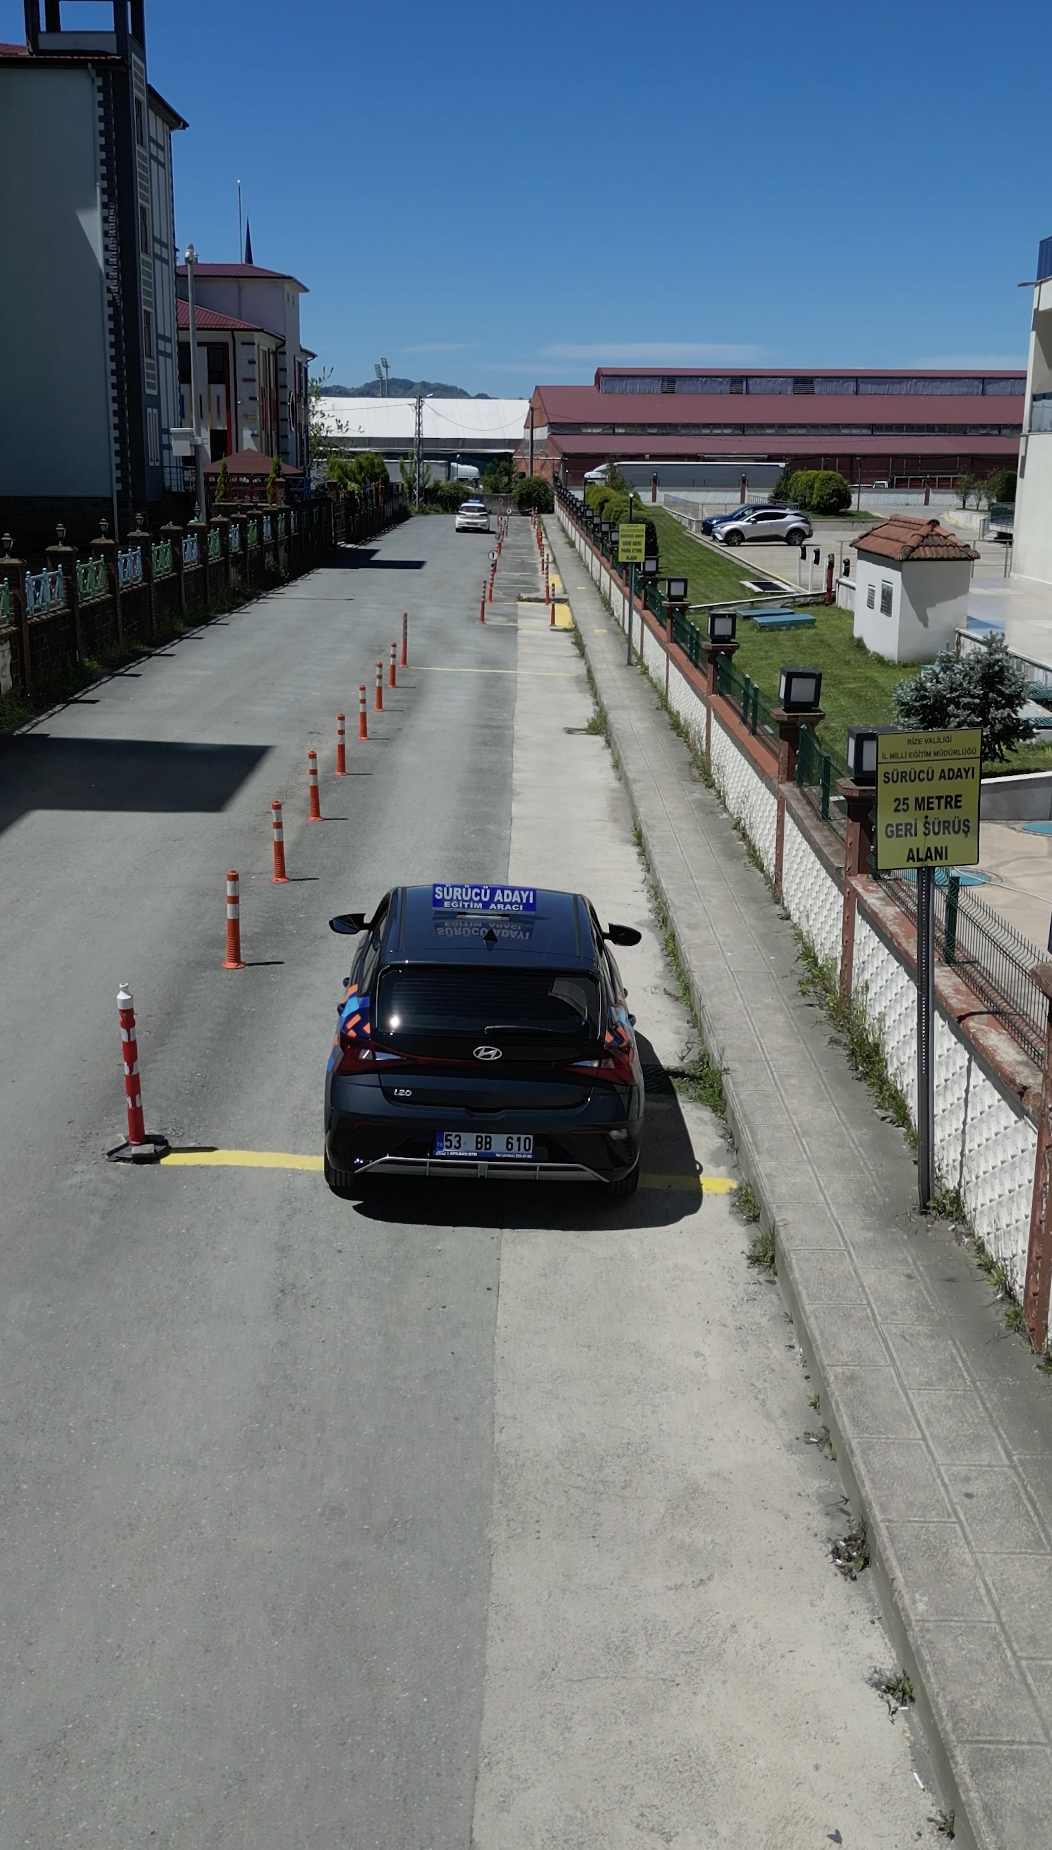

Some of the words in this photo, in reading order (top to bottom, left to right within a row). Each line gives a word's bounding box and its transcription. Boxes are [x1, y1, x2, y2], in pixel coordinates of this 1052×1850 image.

[907, 736, 923, 745] RİZE
[924, 735, 953, 744] VALİLİĞİ
[881, 751, 888, 759] İL
[889, 750, 907, 759] MİLLİ
[908, 749, 932, 758] EĞİTİM
[933, 746, 977, 757] MÜDÜRLÜĞÜ
[883, 766, 935, 784] SÜRÜCÜ
[938, 766, 975, 781] ADAYI
[893, 797, 910, 813] 25
[914, 794, 963, 811] METRE
[884, 818, 918, 839] GERİ
[922, 817, 971, 838] SÜRÜŞ
[906, 845, 949, 863] ALANI
[434, 883, 491, 902] SÜRÜCÜ
[493, 889, 534, 904] ADAYI
[443, 901, 483, 909] EĞİTİM
[489, 903, 523, 911] ARACI
[444, 1133, 462, 1150] 53
[475, 1134, 493, 1151] BB
[505, 1136, 532, 1152] 610
